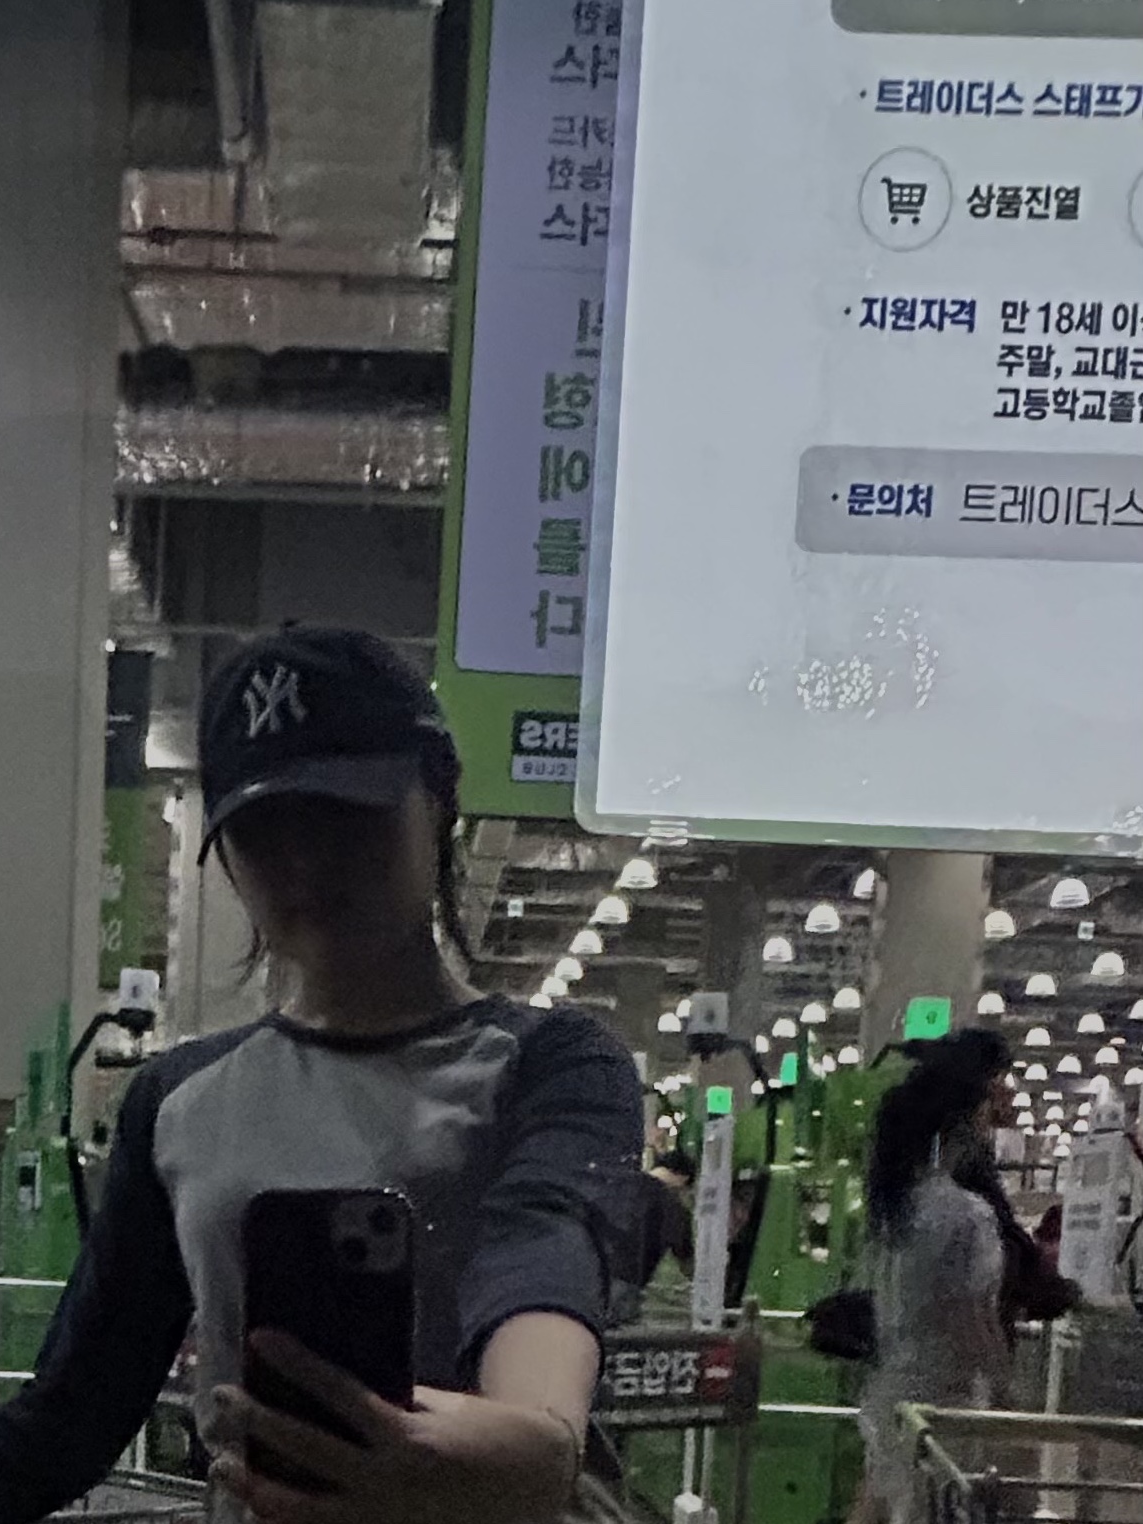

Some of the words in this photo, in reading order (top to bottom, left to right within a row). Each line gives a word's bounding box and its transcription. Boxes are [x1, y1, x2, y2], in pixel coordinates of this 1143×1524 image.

[875, 79, 1023, 116] 트레이더스
[966, 185, 1081, 220] 상품진열
[859, 296, 977, 333] 지원자격
[1000, 300, 1029, 335] 만
[1037, 301, 1103, 336] 18세
[1111, 302, 1143, 337] 이
[996, 343, 1063, 380] 주말,
[993, 387, 1143, 423] 고등학교졸
[847, 483, 934, 518] 문의처
[959, 484, 1143, 526] 트레이더스
